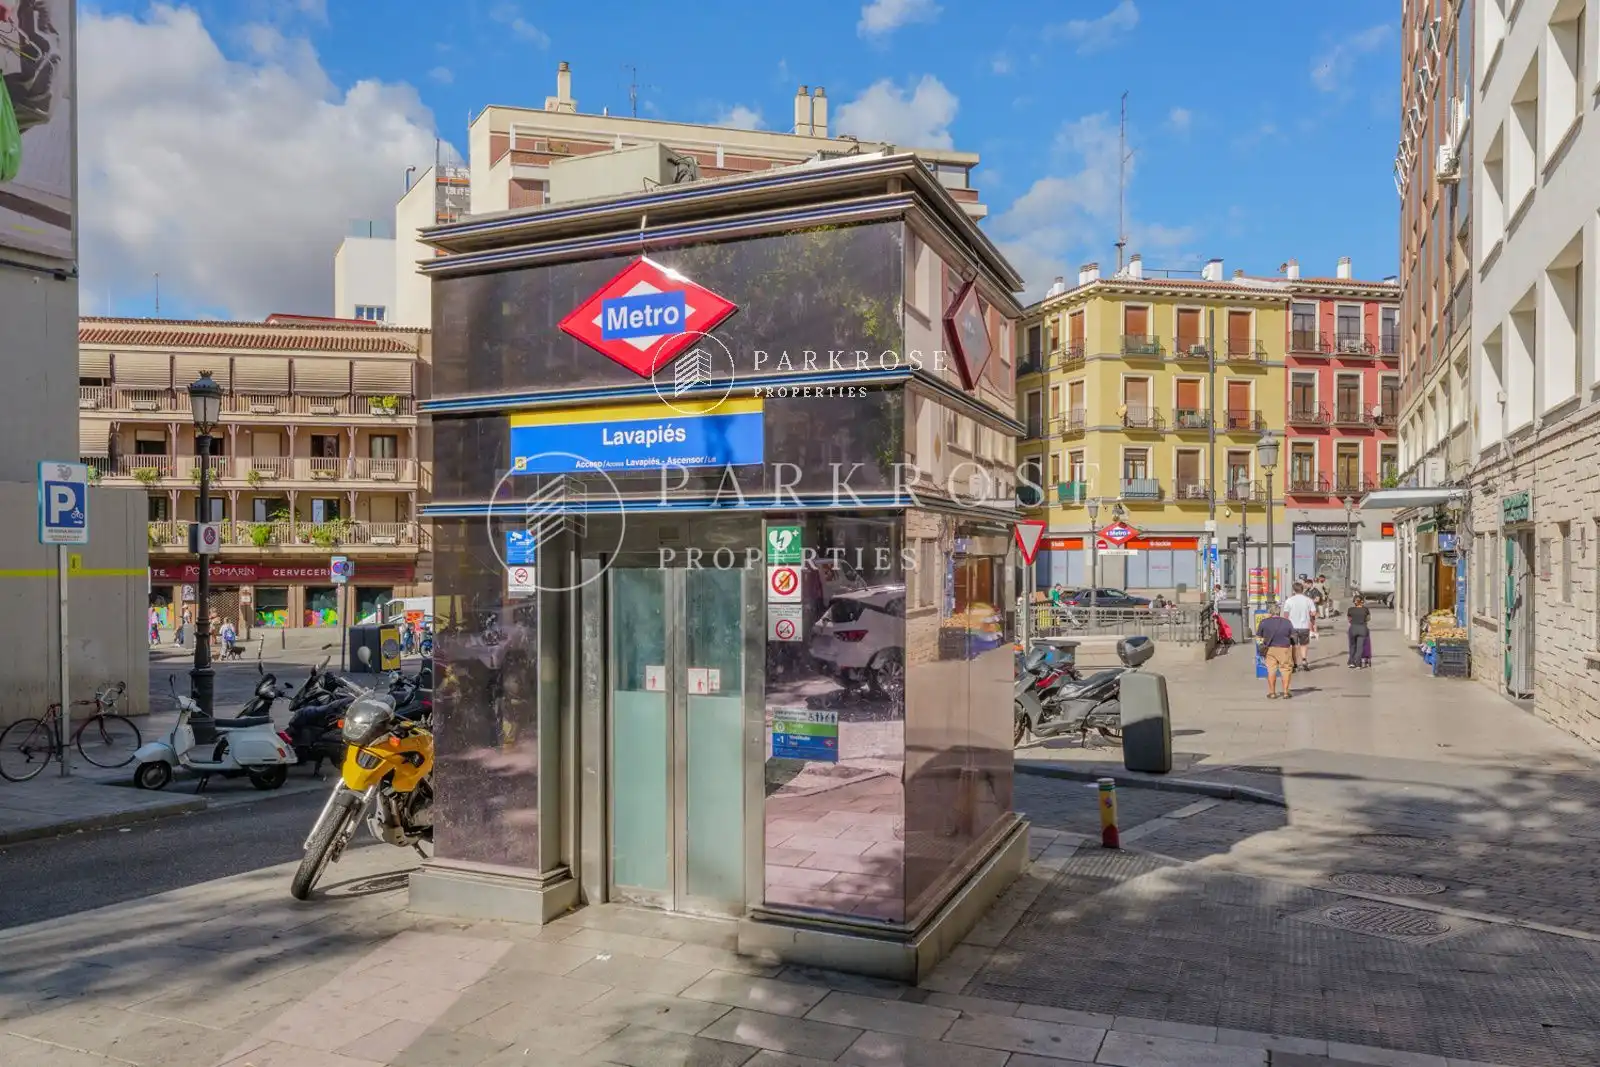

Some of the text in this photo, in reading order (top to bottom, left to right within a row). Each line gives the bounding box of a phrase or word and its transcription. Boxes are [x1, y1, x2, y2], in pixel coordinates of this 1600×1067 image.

[606, 304, 680, 331] Metro
[602, 424, 687, 448] Lavapiés
[50, 485, 76, 524] P
